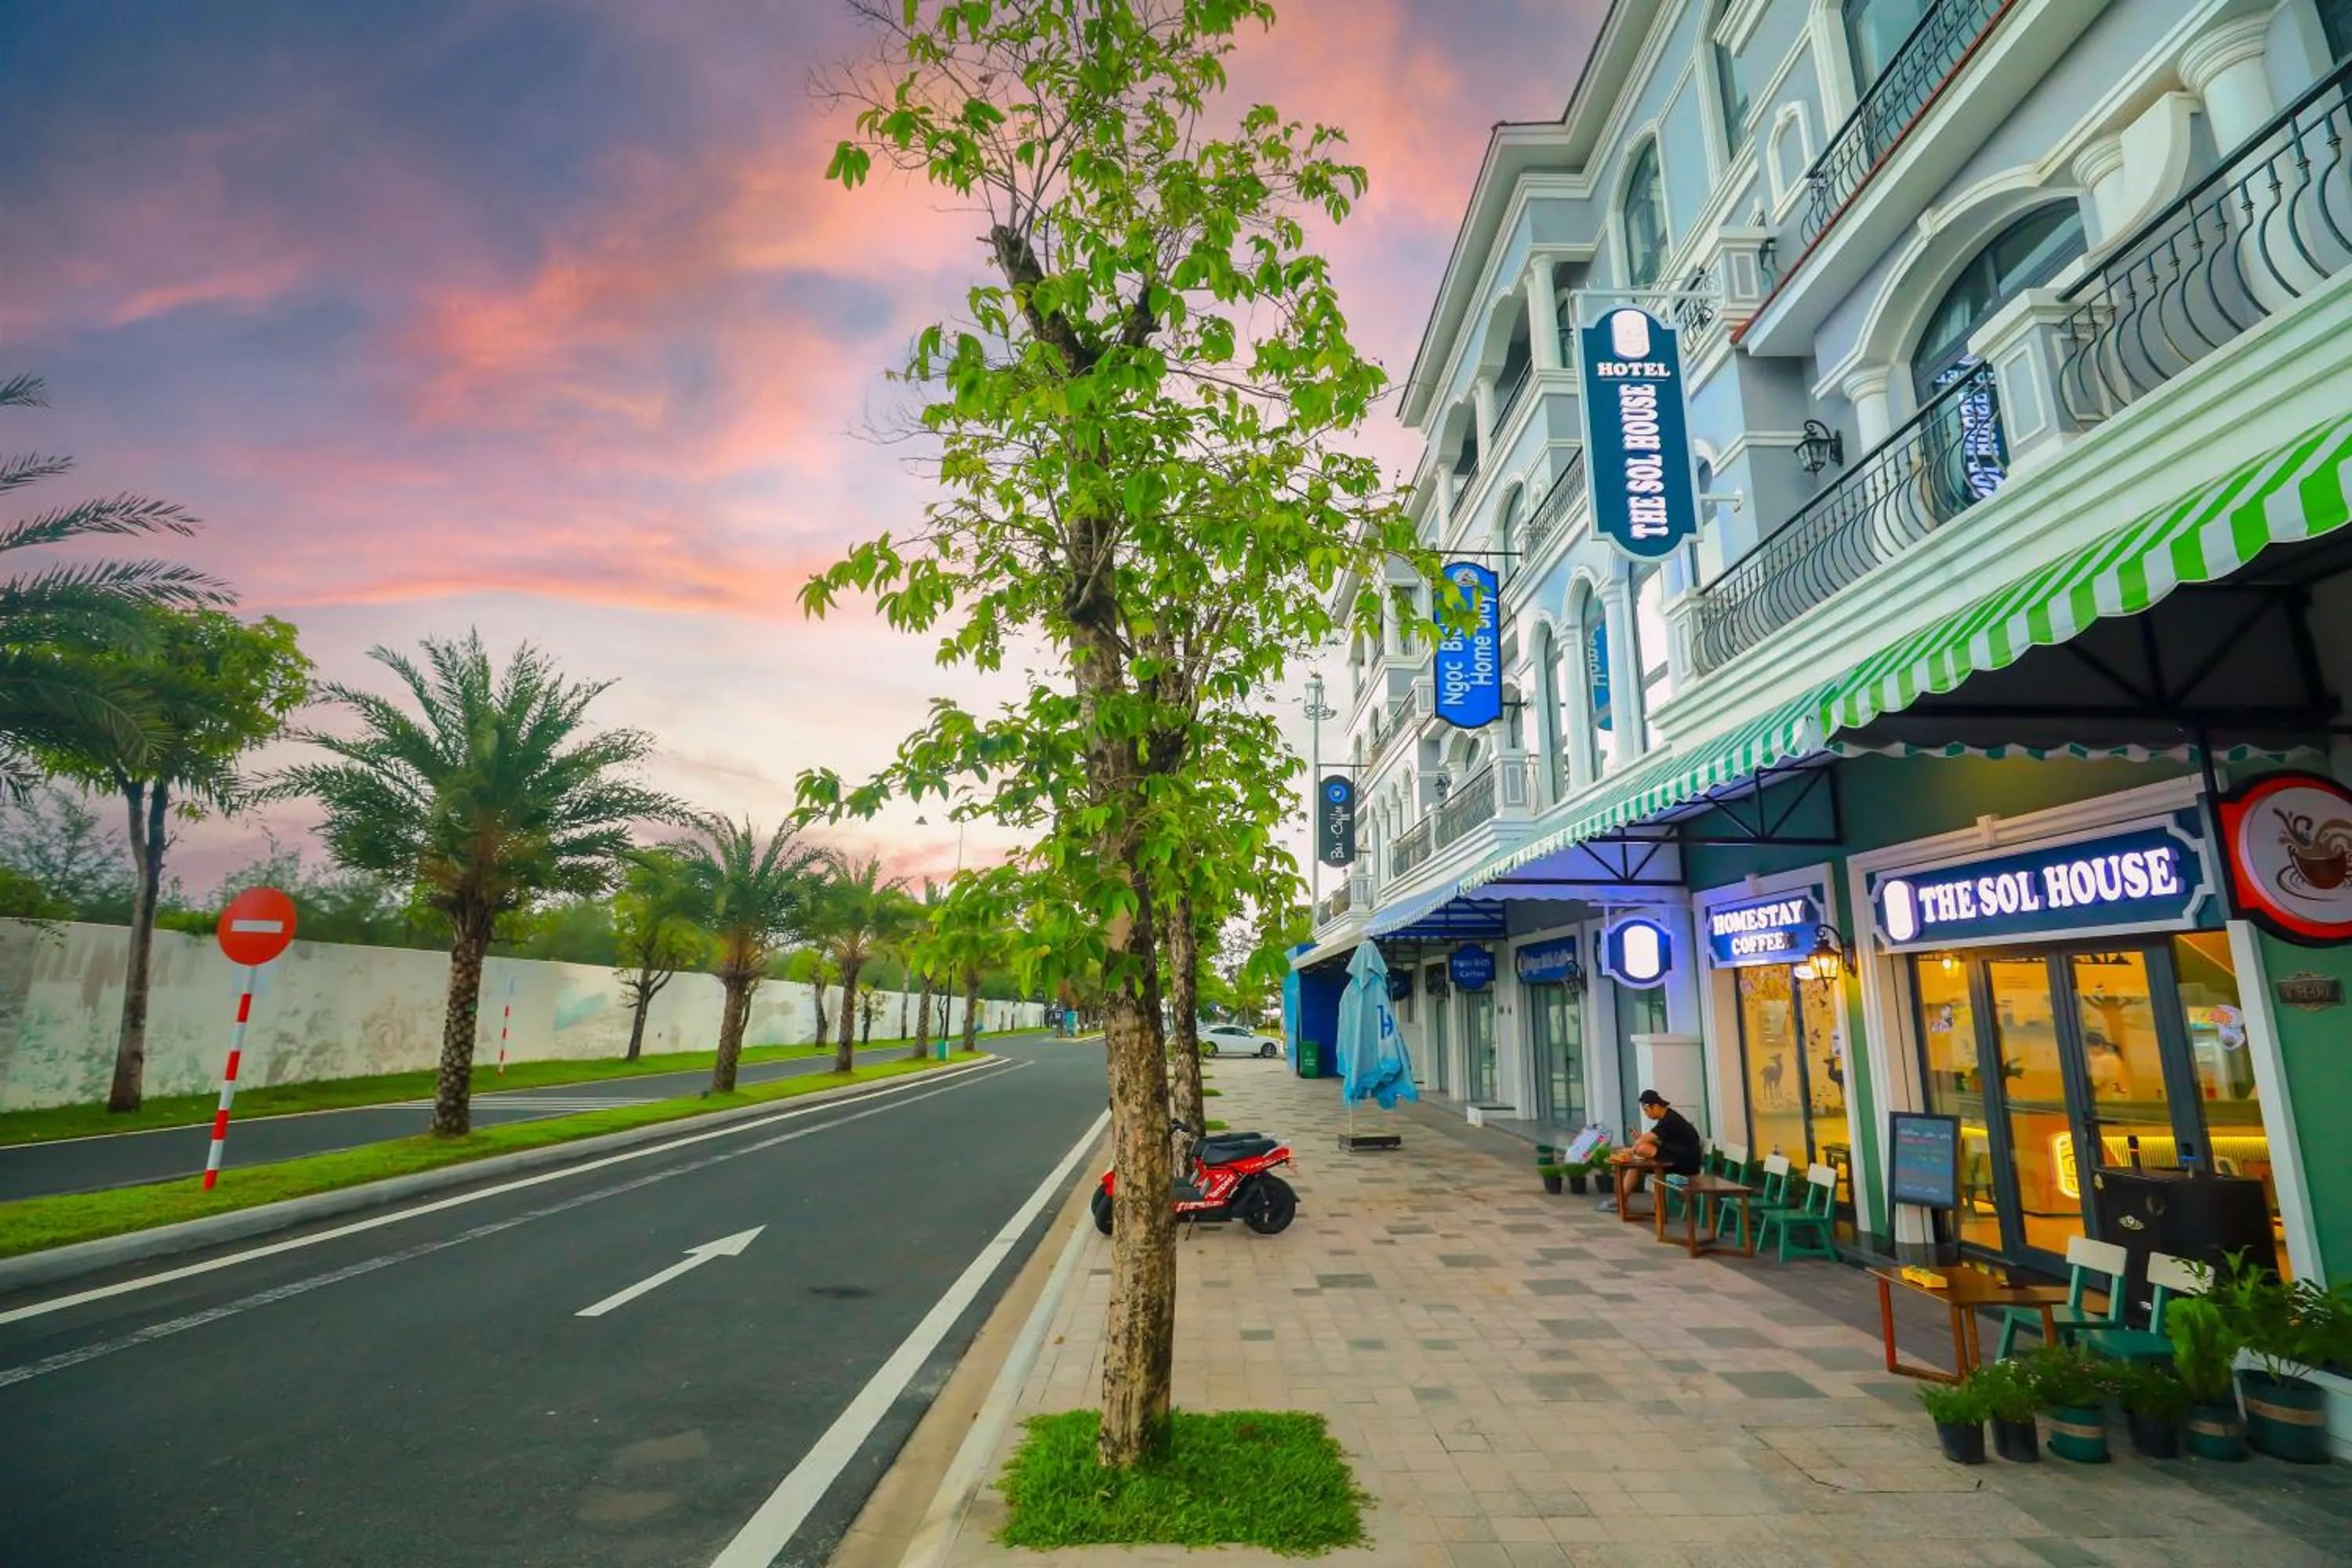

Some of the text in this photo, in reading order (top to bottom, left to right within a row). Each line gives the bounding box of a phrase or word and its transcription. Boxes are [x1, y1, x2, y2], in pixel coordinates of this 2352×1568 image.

[1597, 362, 1671, 377] HOTEL
[1619, 384, 1668, 539] THE SOL HOUSE
[1470, 635, 1494, 686] Home
[1442, 661, 1471, 706] Ngọc
[1918, 847, 2178, 924] THE SOL HOUSE
[1711, 899, 1803, 936] HOMESTAY
[1730, 931, 1786, 956] COFFEE
